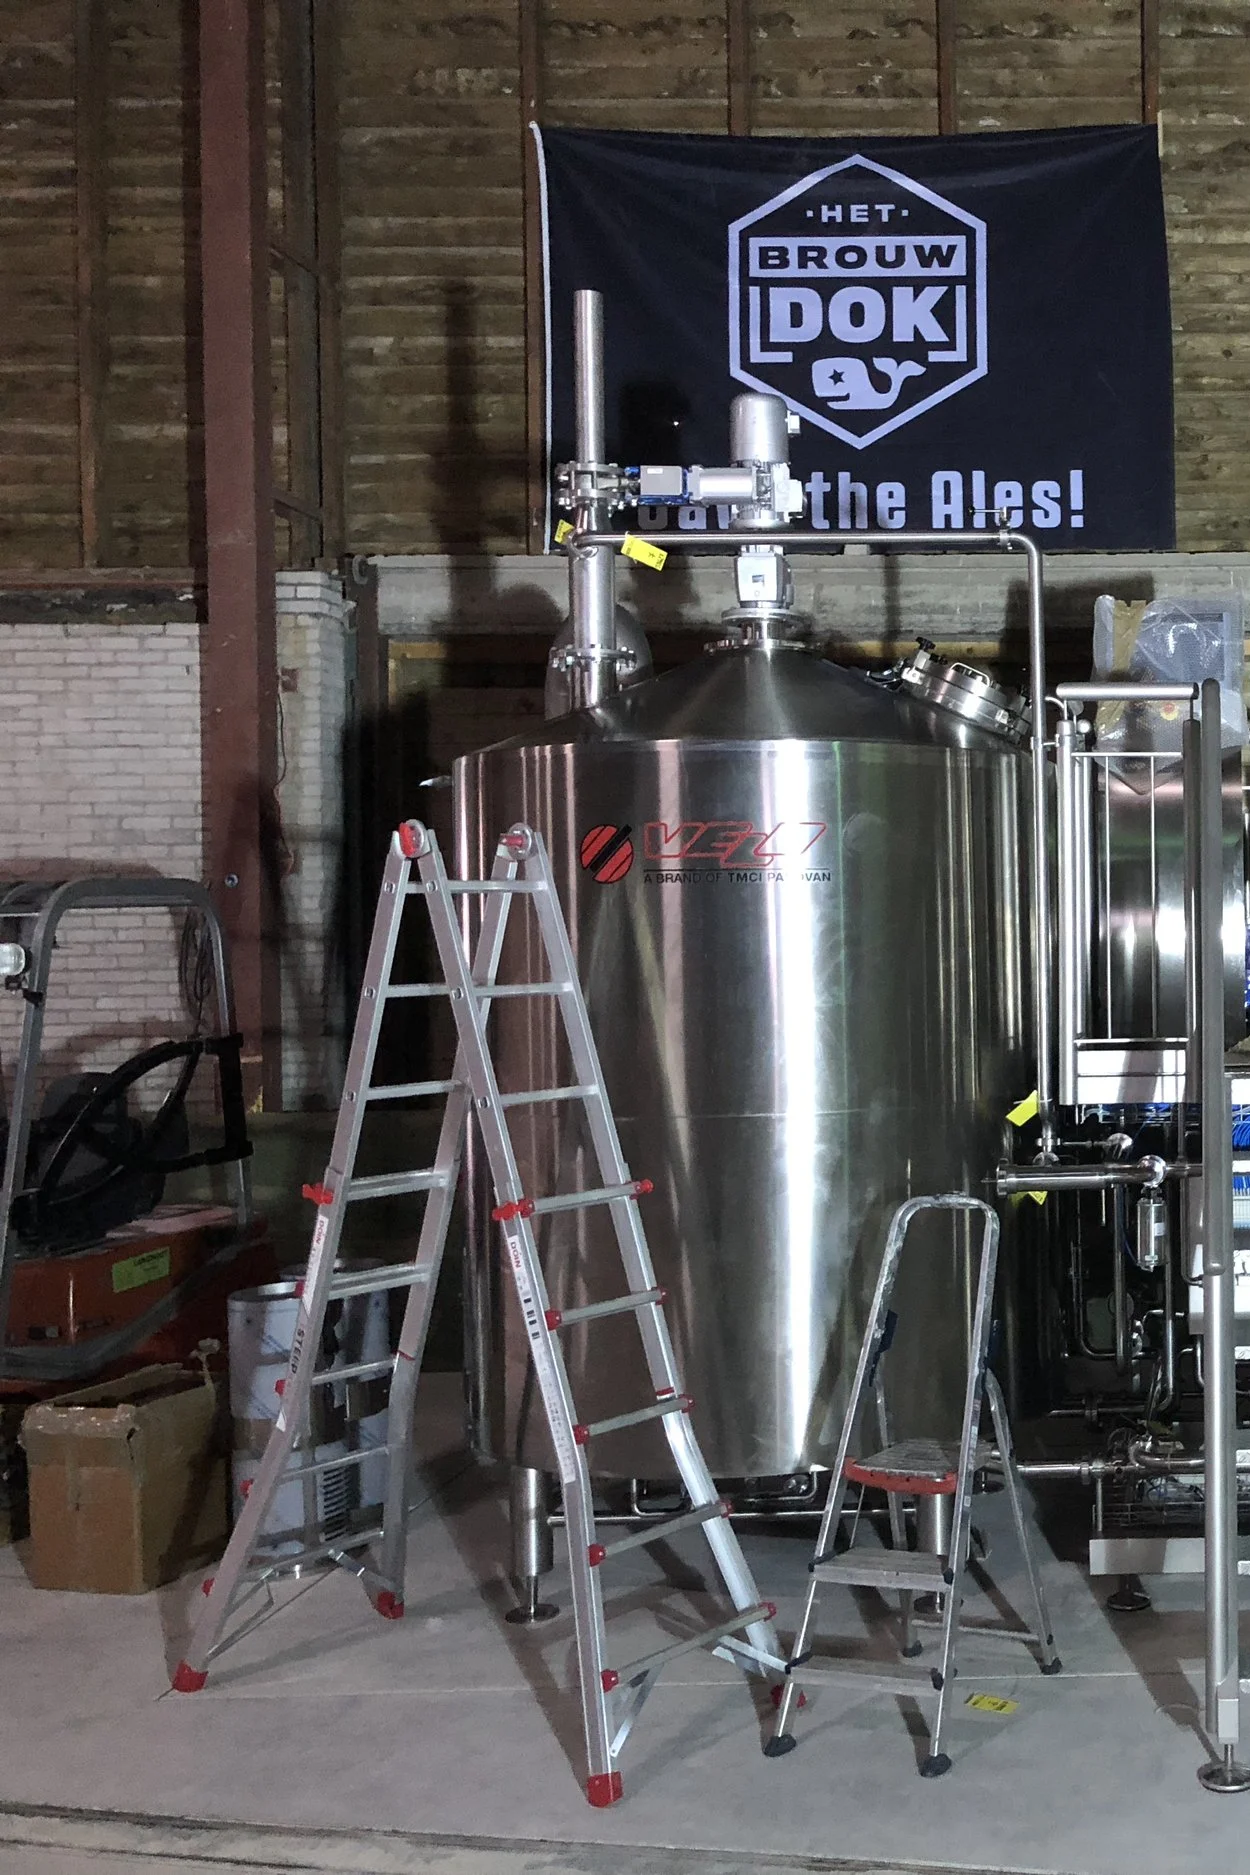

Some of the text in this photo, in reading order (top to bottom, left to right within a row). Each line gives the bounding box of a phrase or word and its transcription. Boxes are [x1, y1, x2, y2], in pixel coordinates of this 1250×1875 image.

[821, 204, 896, 223] HET
[758, 244, 958, 270] BROUW
[769, 286, 950, 343] DOK
[805, 471, 906, 529] the
[931, 469, 1085, 529] Ales!
[643, 872, 831, 884] A BRAND OF TMCI PAVAN
